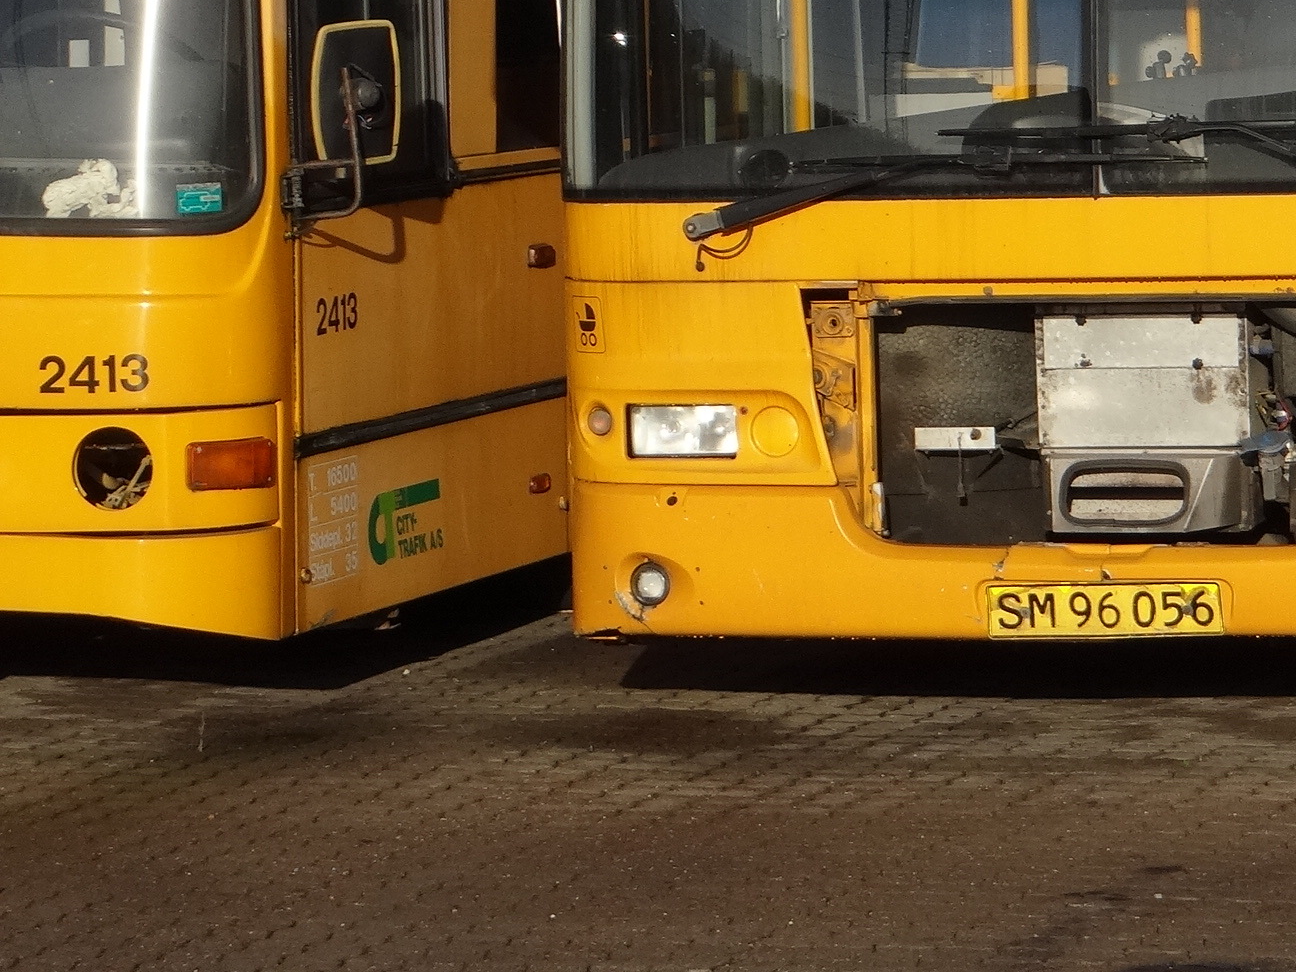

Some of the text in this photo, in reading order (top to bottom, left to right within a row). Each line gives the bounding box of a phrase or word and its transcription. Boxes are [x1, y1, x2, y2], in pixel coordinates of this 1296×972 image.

[316, 292, 358, 336] 2413
[39, 353, 150, 394] 2413
[327, 461, 357, 487] 16500
[330, 491, 357, 516] 5400
[398, 528, 444, 560] TRAFIK A/S
[998, 590, 1215, 629] SM 96 056
